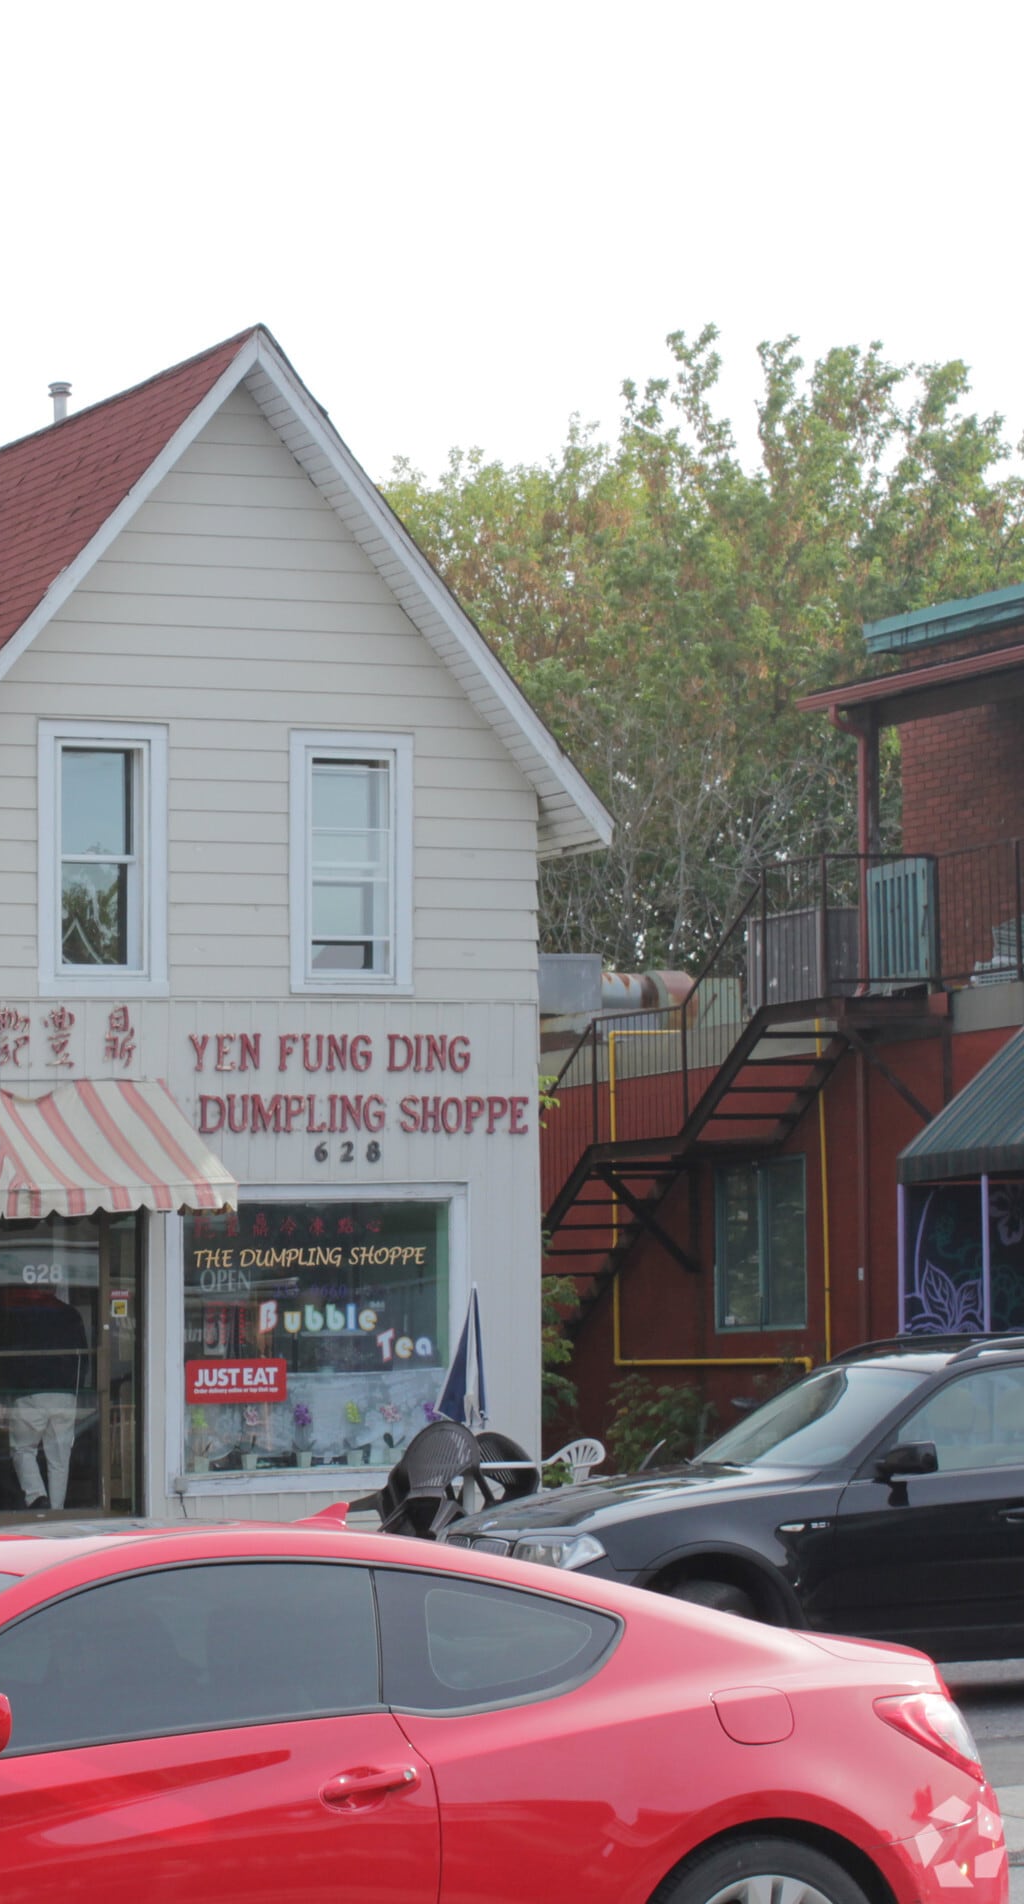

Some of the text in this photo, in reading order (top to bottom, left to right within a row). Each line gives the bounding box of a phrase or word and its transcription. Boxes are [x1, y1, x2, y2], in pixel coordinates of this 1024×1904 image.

[188, 1033, 471, 1073] YEN FUNG DING
[198, 1093, 530, 1135] DUMPLING SHOPPE
[313, 1140, 382, 1163] 628
[193, 1245, 427, 1269] THE DUMPLING SHOPPE
[21, 1263, 63, 1285] 628
[199, 1269, 253, 1292] OPEN
[259, 1299, 378, 1334] Bubble
[377, 1327, 433, 1363] Tea
[194, 1366, 278, 1387] JUST EAT
